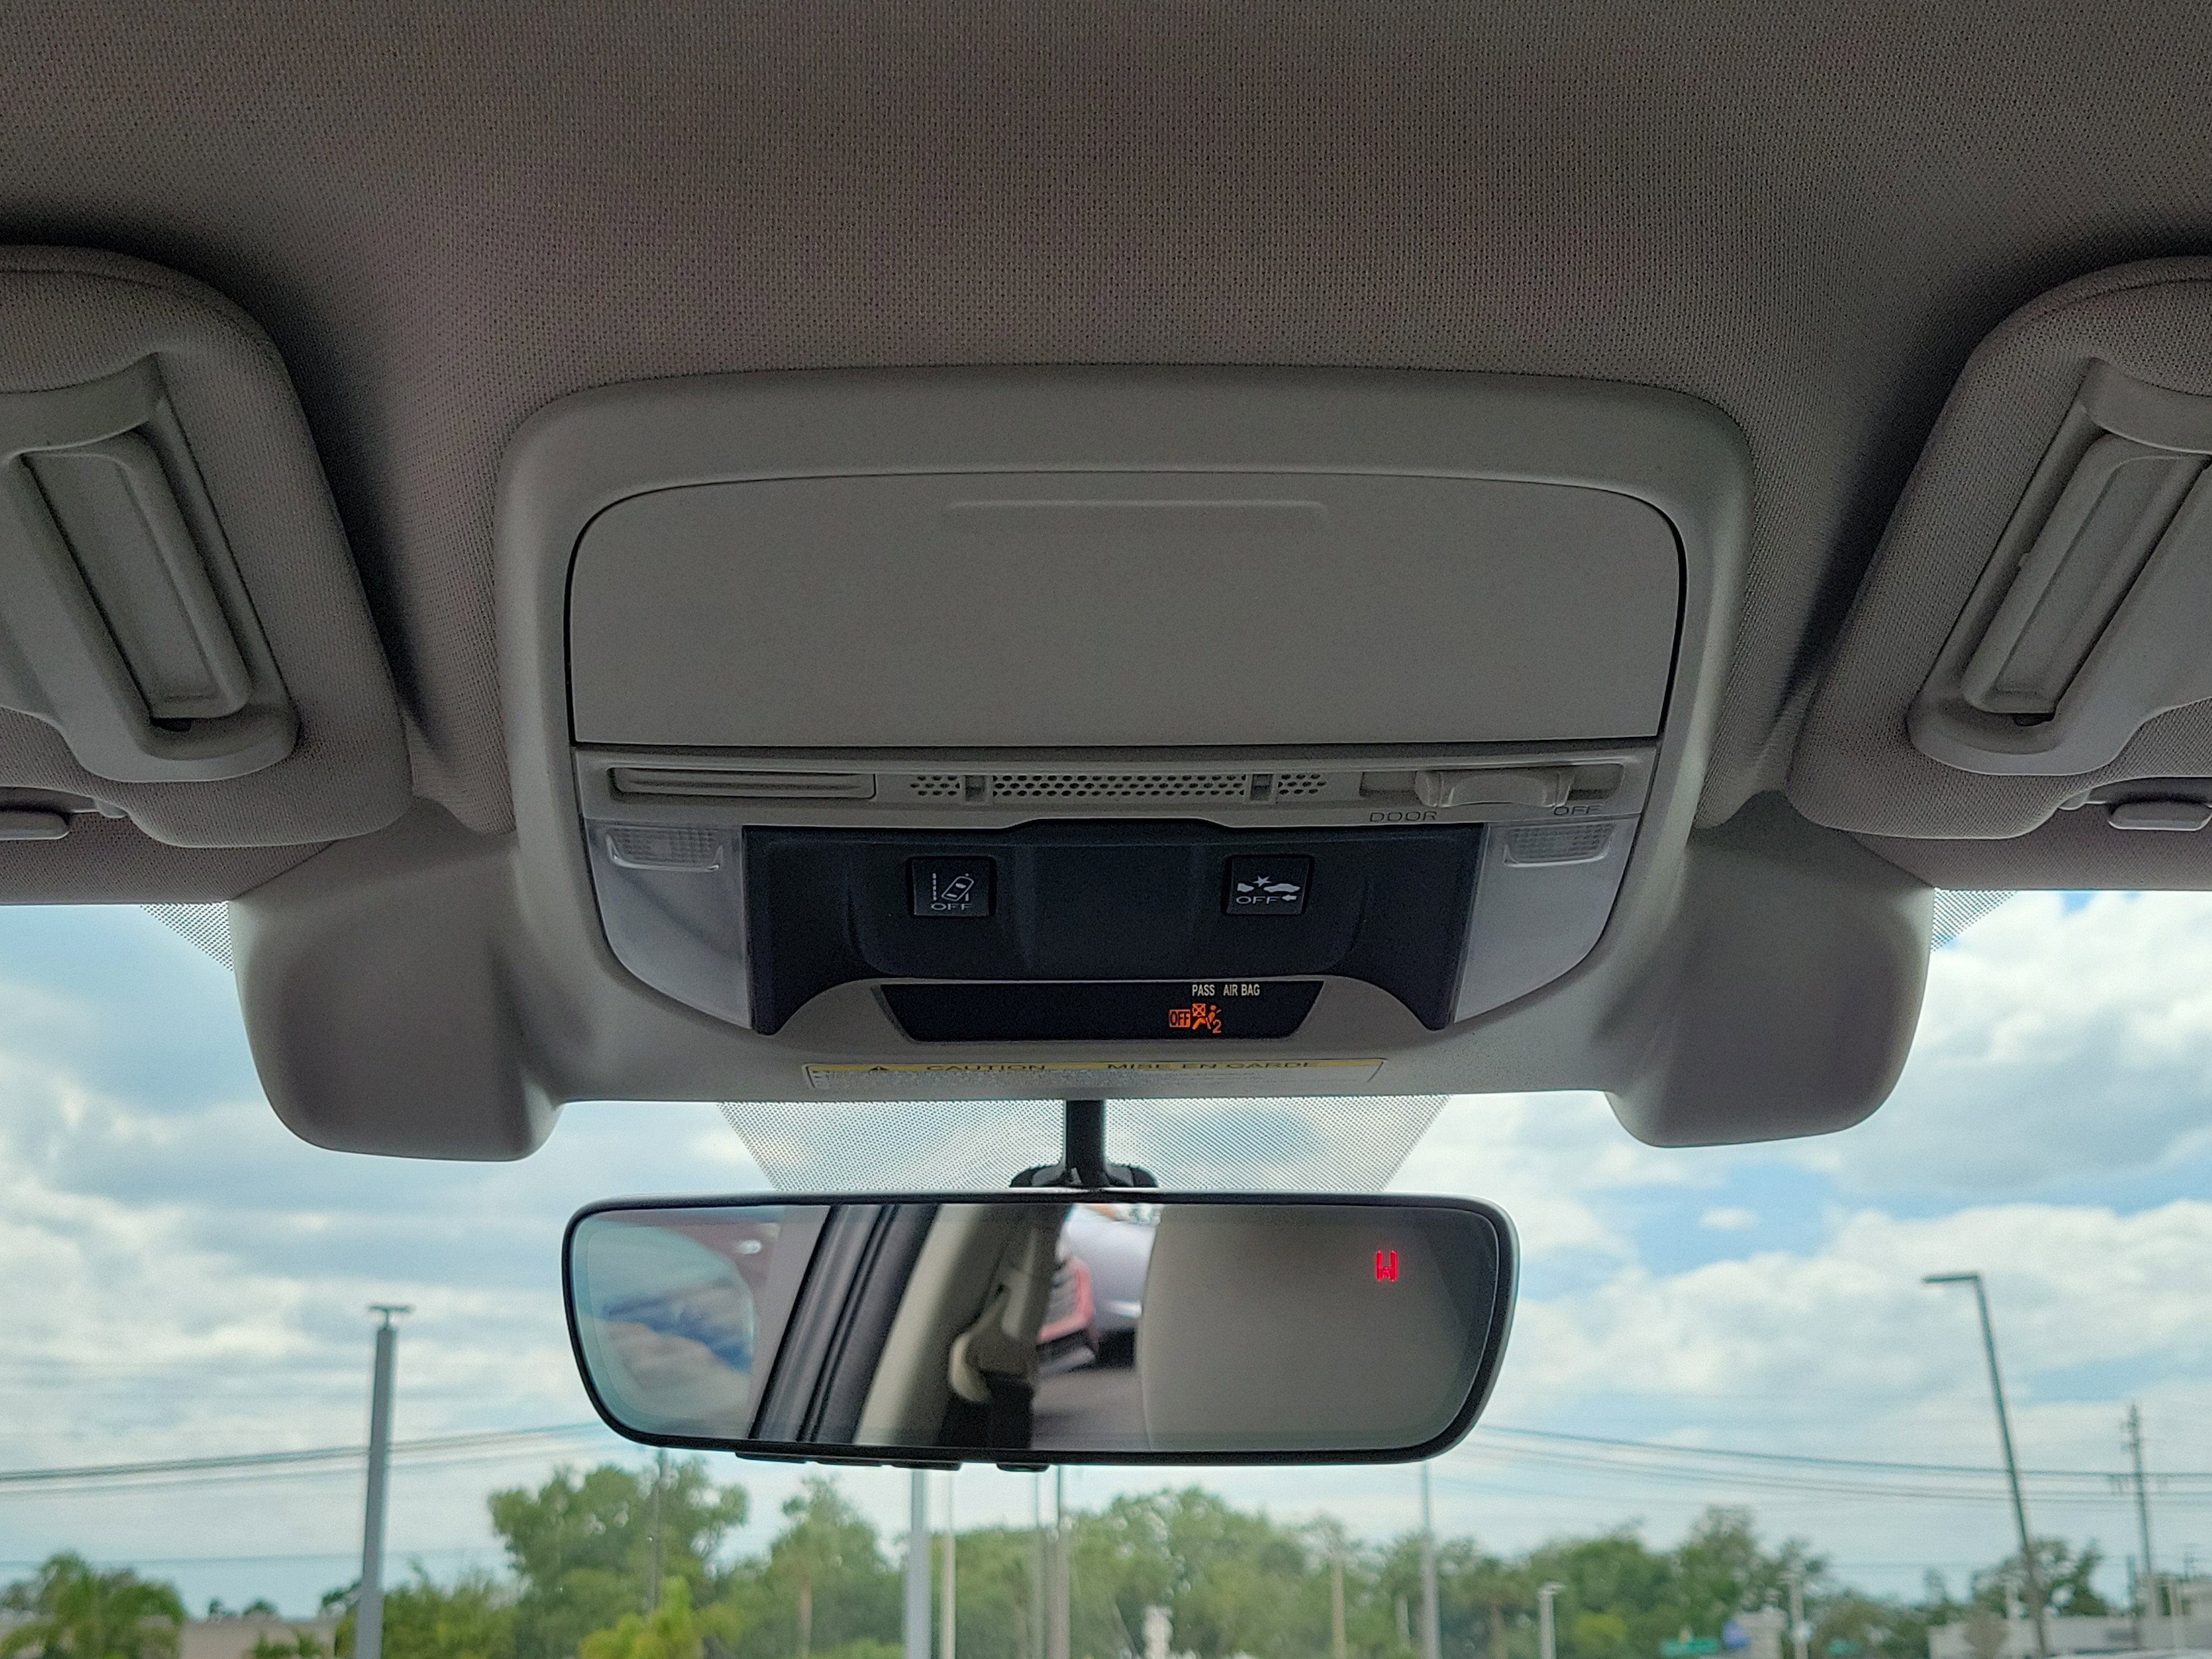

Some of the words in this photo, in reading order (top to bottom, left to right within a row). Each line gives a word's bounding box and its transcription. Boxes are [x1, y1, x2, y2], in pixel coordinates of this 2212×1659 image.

[1369, 810, 1438, 822] DOOR
[1553, 805, 1604, 816] OFF
[1235, 895, 1280, 904] OFF
[930, 902, 972, 911] OFF
[1191, 984, 1216, 997] PASS
[1222, 984, 1239, 996] AIR
[1240, 983, 1261, 996] BAG
[1170, 1010, 1190, 1028] OFF
[1212, 1019, 1222, 1034] 2
[1375, 1250, 1397, 1282] W
